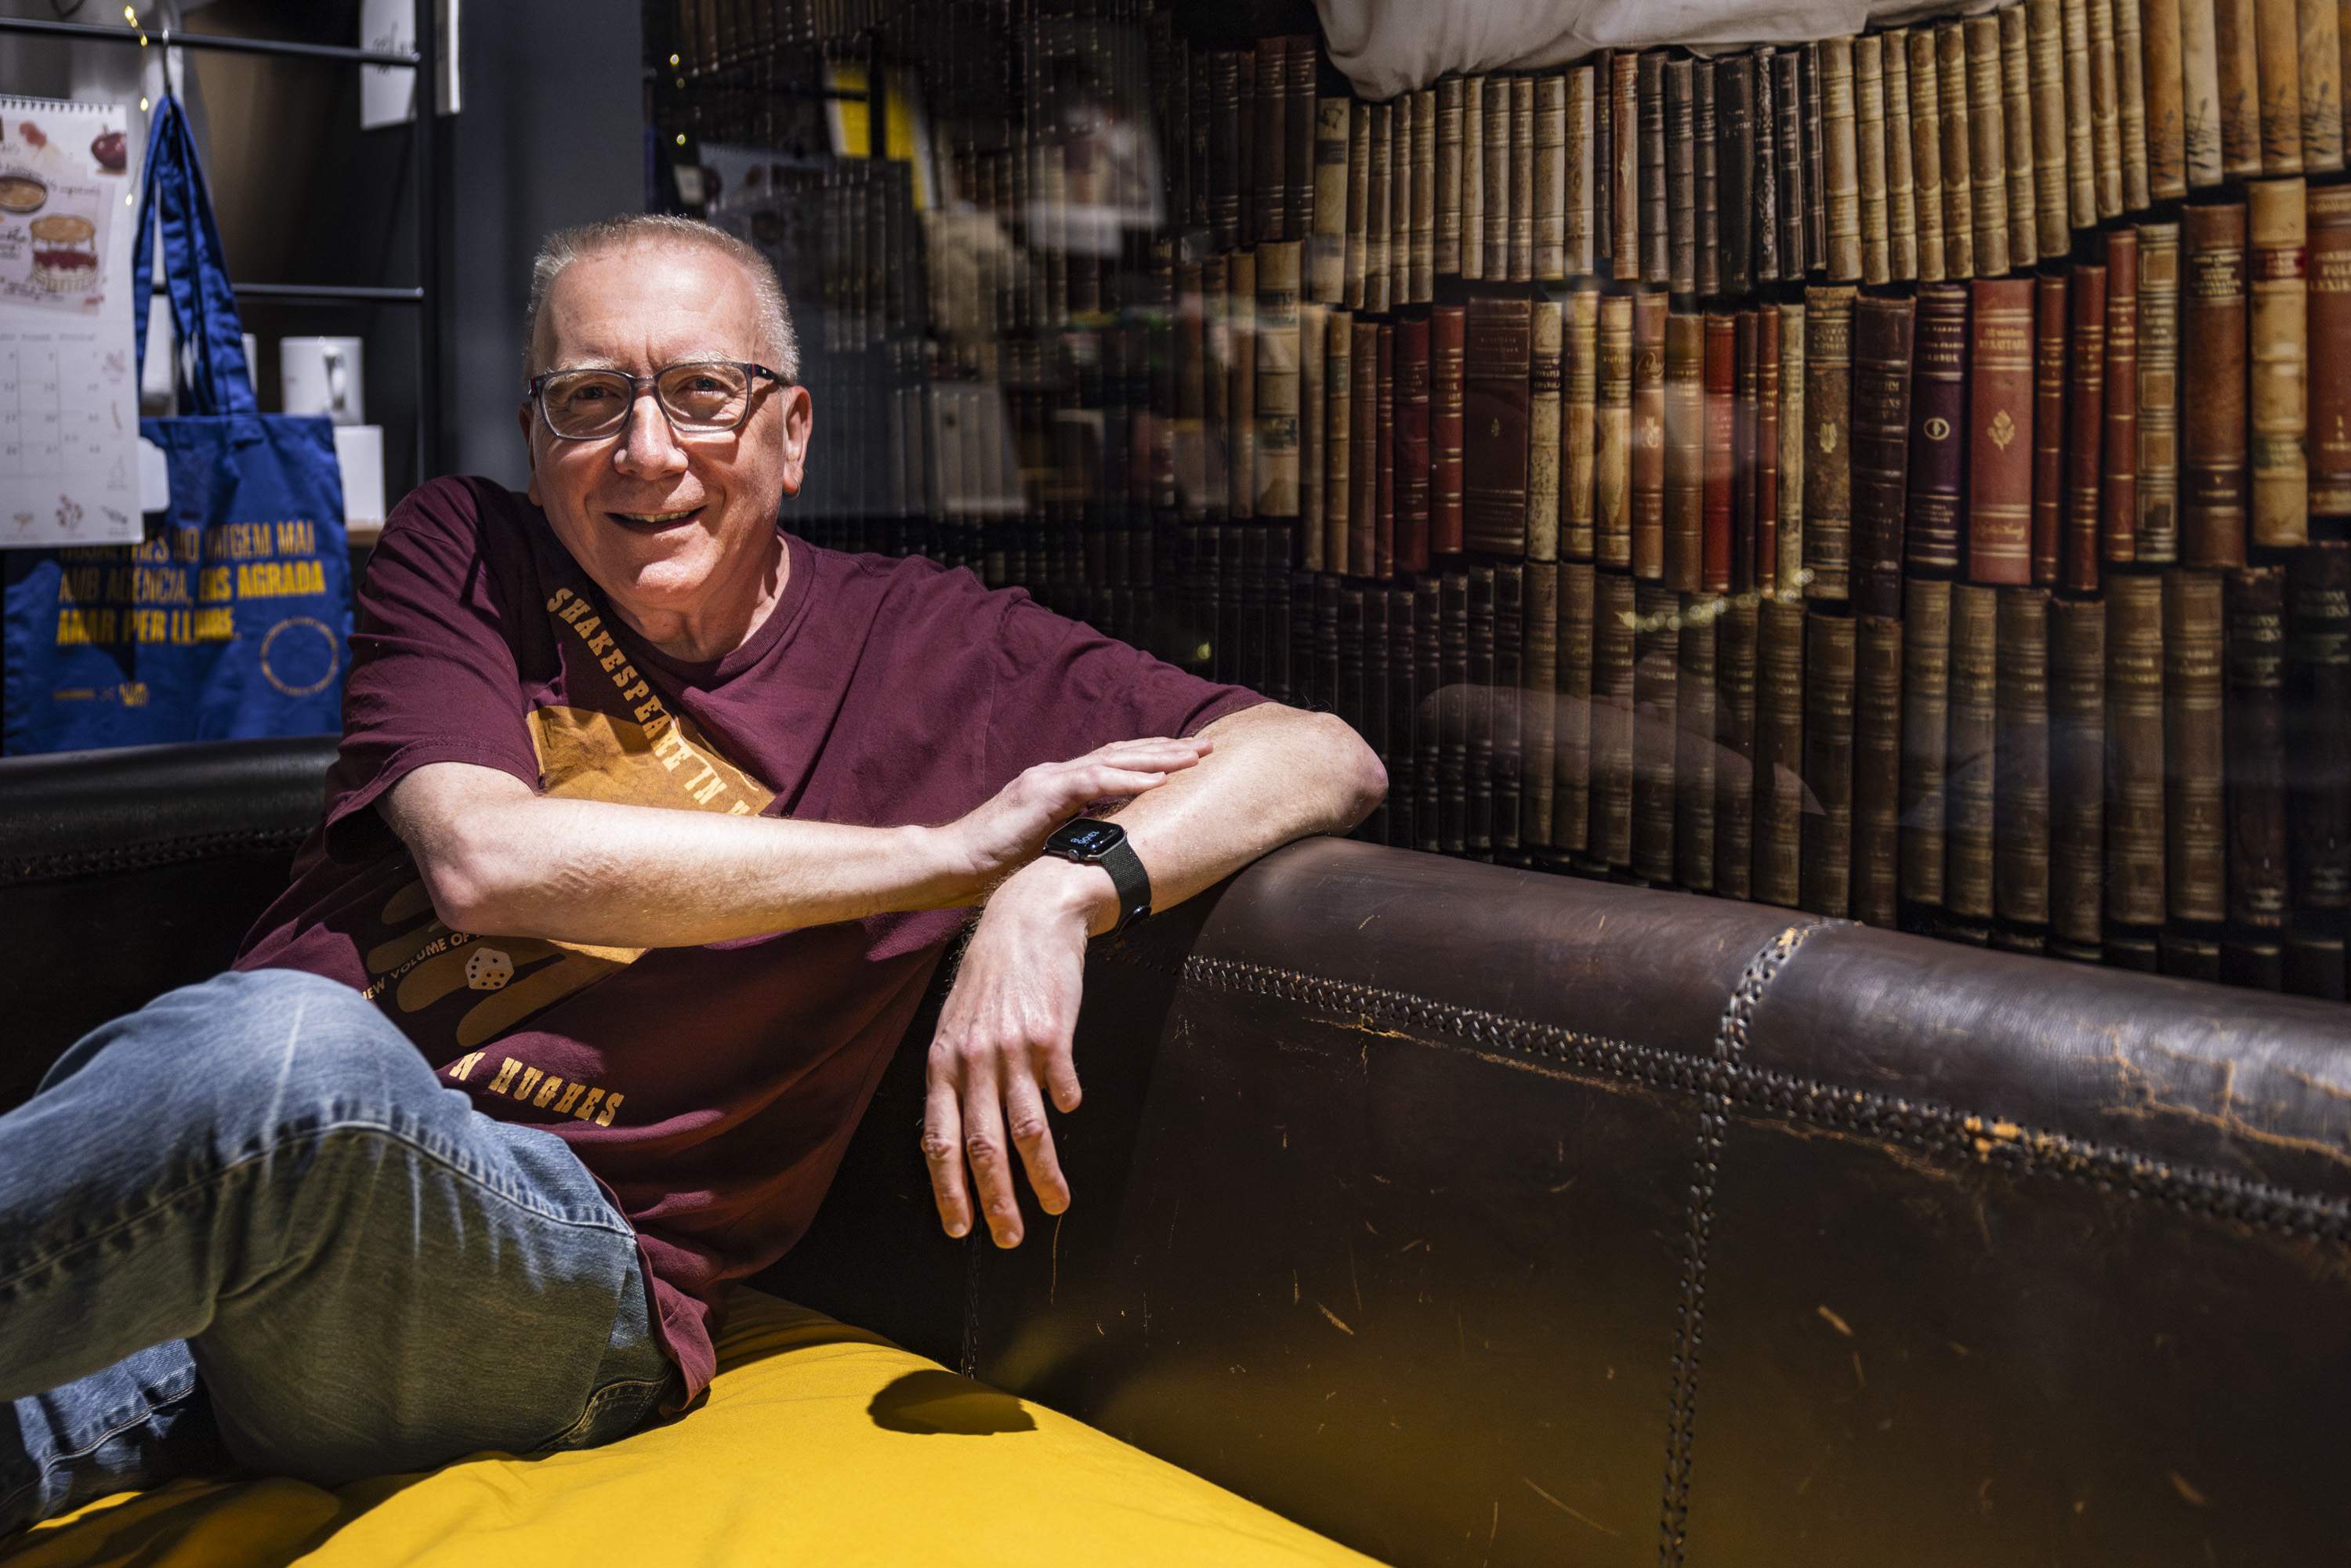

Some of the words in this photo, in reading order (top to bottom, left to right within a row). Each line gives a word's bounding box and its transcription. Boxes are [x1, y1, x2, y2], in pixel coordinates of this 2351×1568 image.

[276, 520, 315, 556] MAI
[237, 560, 326, 599] AGRADA
[547, 588, 694, 772] SHAKESPEARE
[684, 765, 728, 806] IN
[390, 938, 447, 979] VOLUME
[451, 932, 469, 947] OF
[487, 1056, 625, 1127] HUGHES
